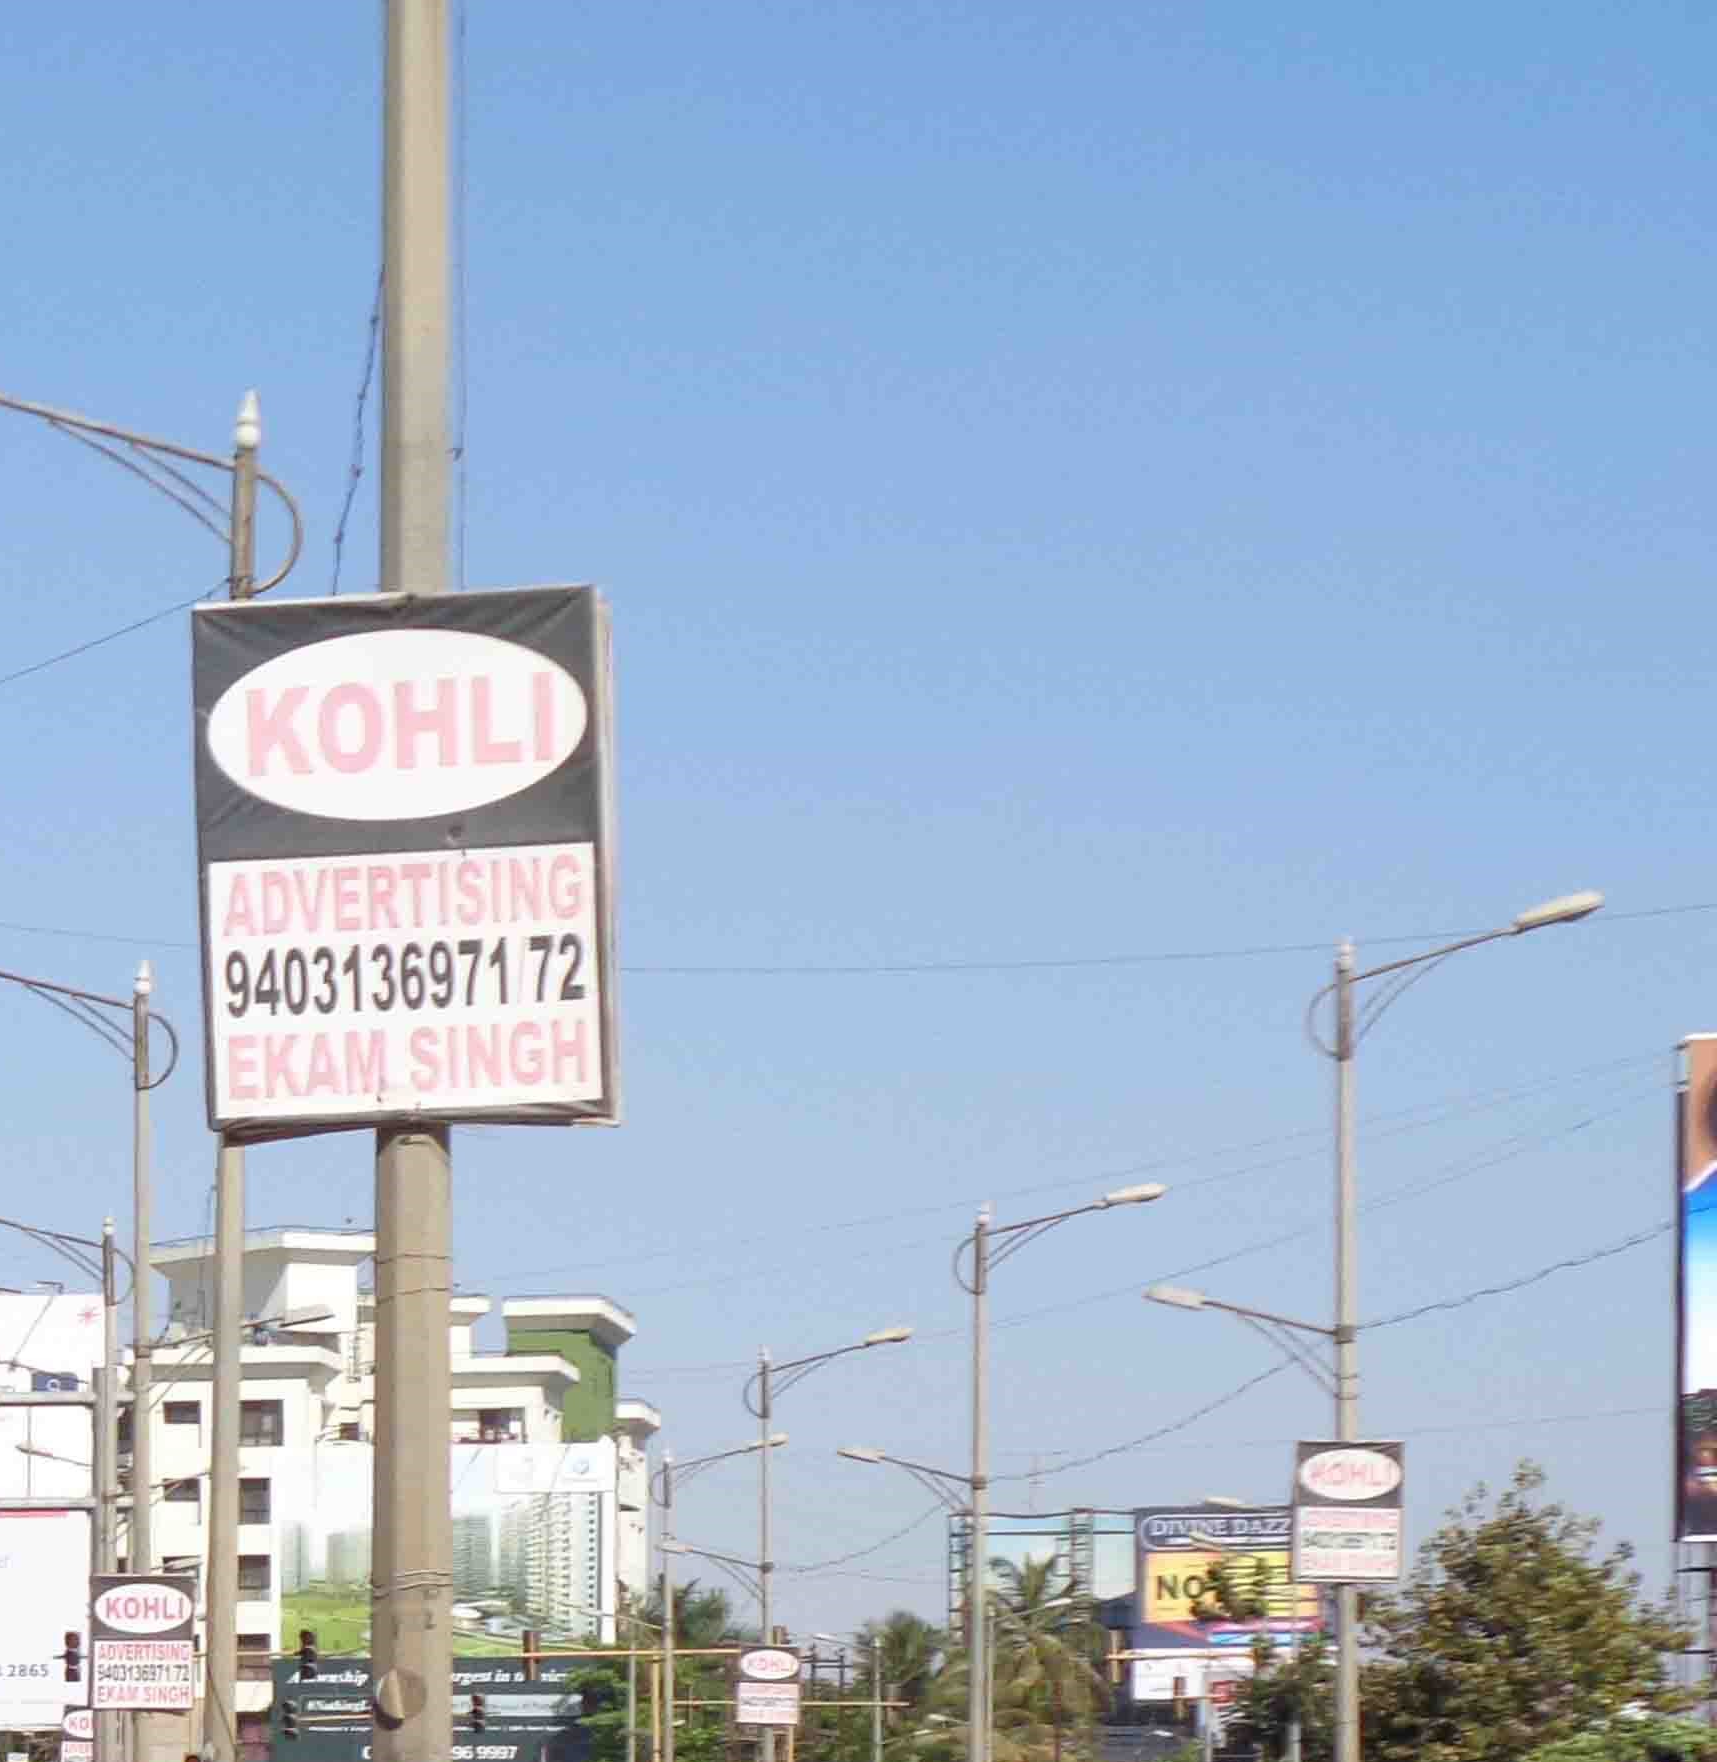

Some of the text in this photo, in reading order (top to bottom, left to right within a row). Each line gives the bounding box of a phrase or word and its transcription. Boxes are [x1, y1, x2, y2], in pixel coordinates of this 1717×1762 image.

[245, 672, 556, 777] KOHLI
[223, 853, 583, 937] ADVERTISING
[229, 1019, 589, 1098] EKAM SINGH
[1149, 1518, 1291, 1538] DIVINE DAZZ
[1157, 1576, 1207, 1600] NO
[106, 1597, 185, 1620] KOHLI
[98, 1643, 190, 1661] ADVERTISING
[7, 1663, 49, 1679] 2865
[98, 1685, 190, 1704] EKAM SINGH
